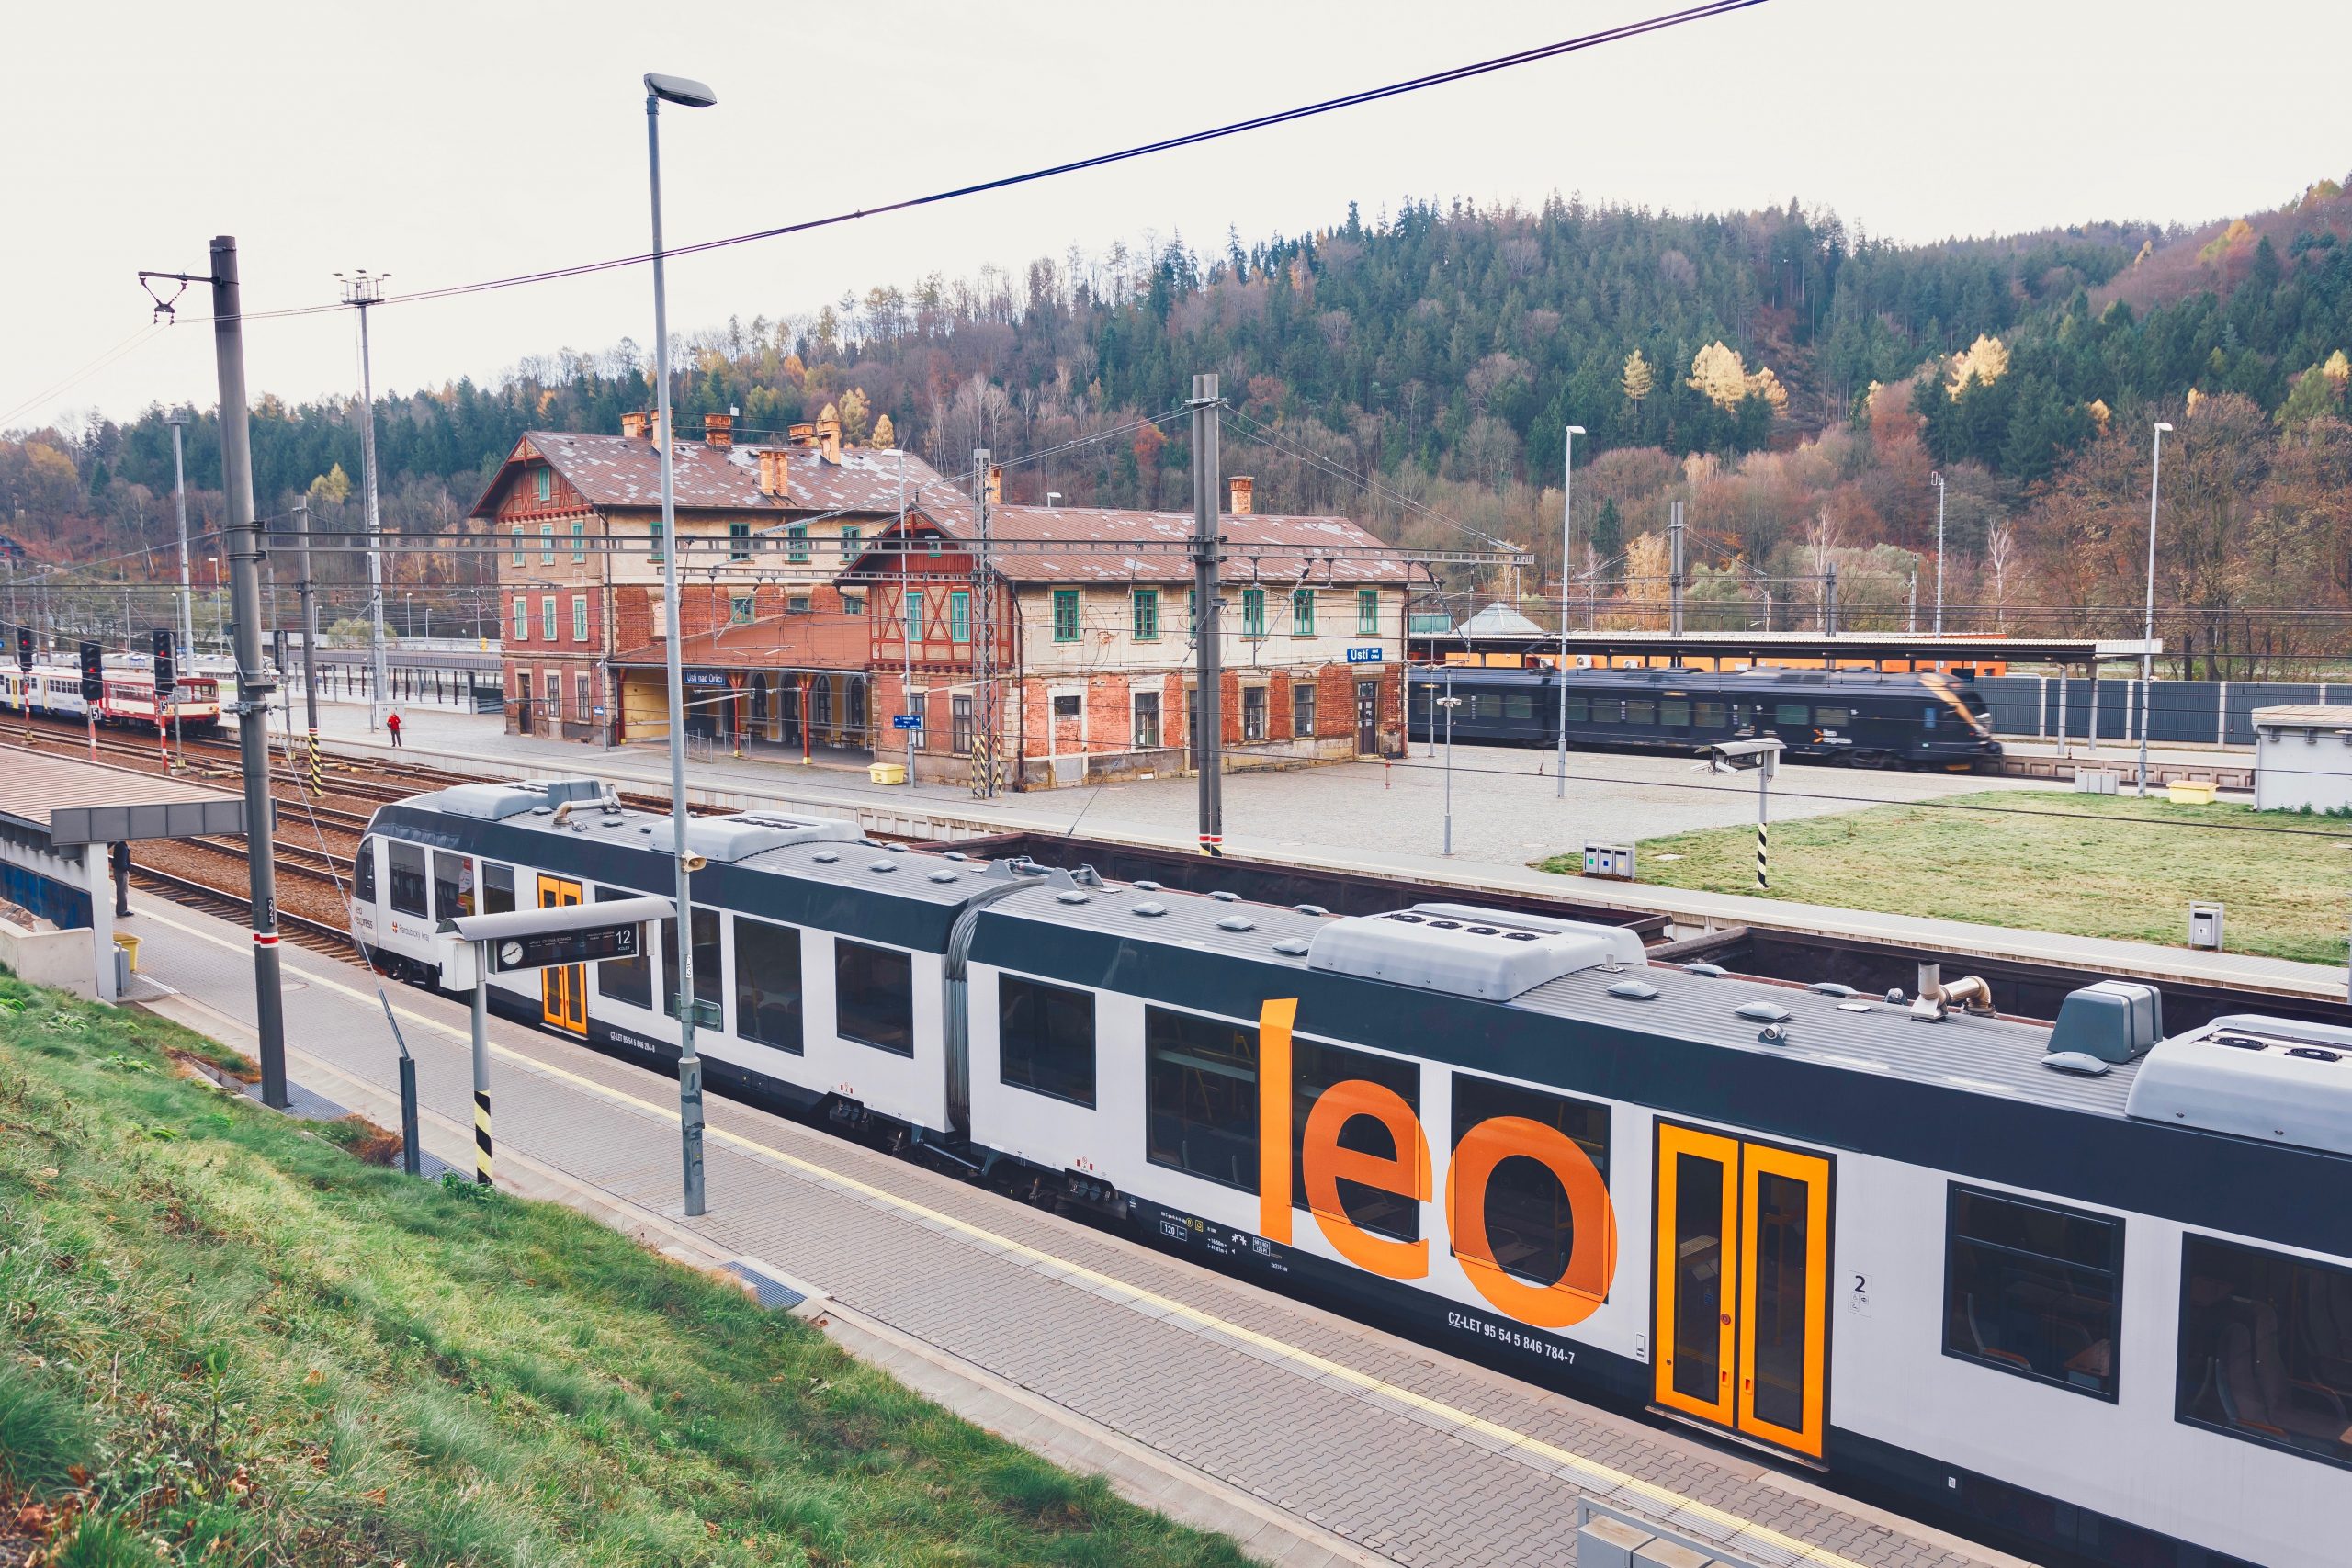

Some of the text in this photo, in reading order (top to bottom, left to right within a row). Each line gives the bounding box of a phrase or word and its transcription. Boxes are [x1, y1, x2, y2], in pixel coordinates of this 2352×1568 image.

[1351, 648, 1369, 660] Ústí
[616, 930, 631, 944] 12
[1260, 998, 1617, 1328] leo
[1164, 1224, 1175, 1235] 120
[1855, 1275, 1866, 1293] 2
[1448, 1312, 1576, 1365] CZ-LET 95 54 5 846 784-7
